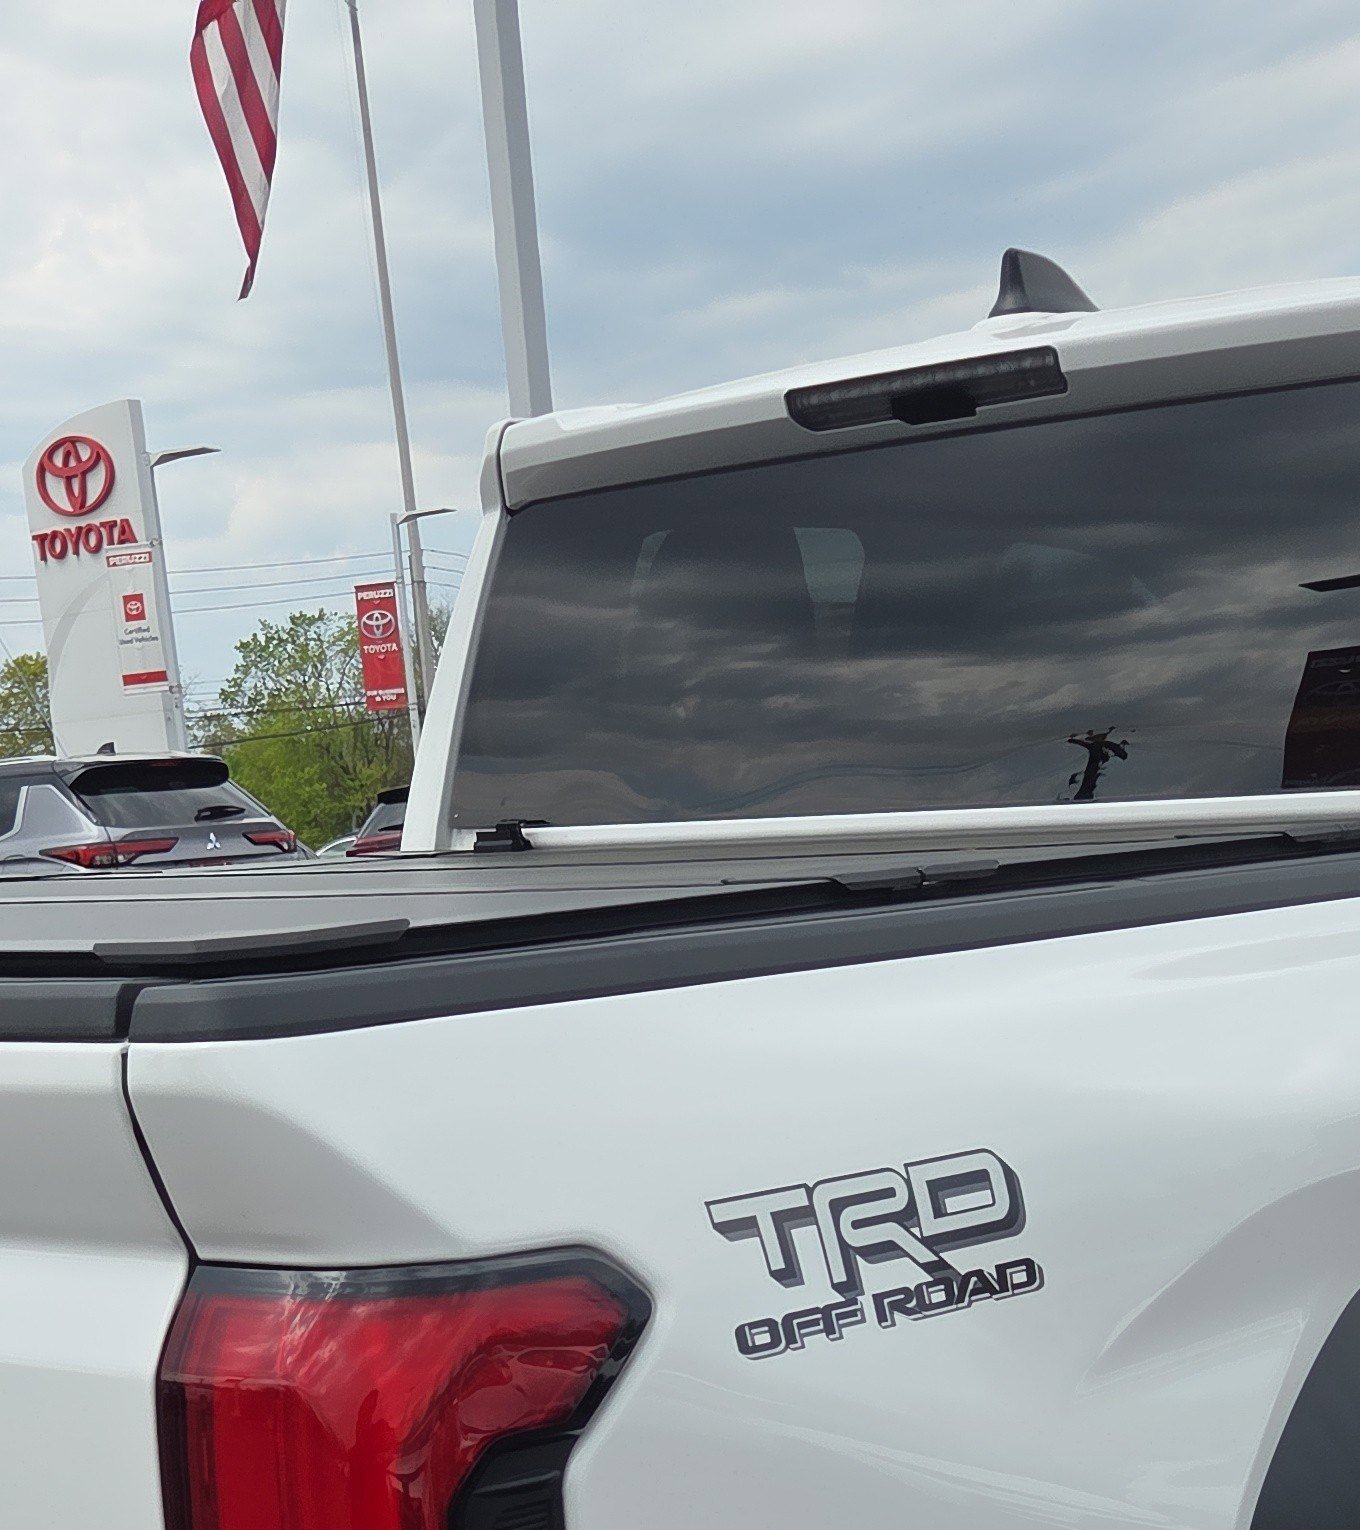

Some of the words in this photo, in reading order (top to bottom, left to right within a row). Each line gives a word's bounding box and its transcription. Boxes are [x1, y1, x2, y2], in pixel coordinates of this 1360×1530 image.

[32, 519, 138, 563] TOYOTA
[363, 643, 398, 654] TOYOTA
[704, 1148, 1027, 1300] TRD
[734, 1298, 868, 1361] OFF
[872, 1257, 1045, 1329] ROAD
